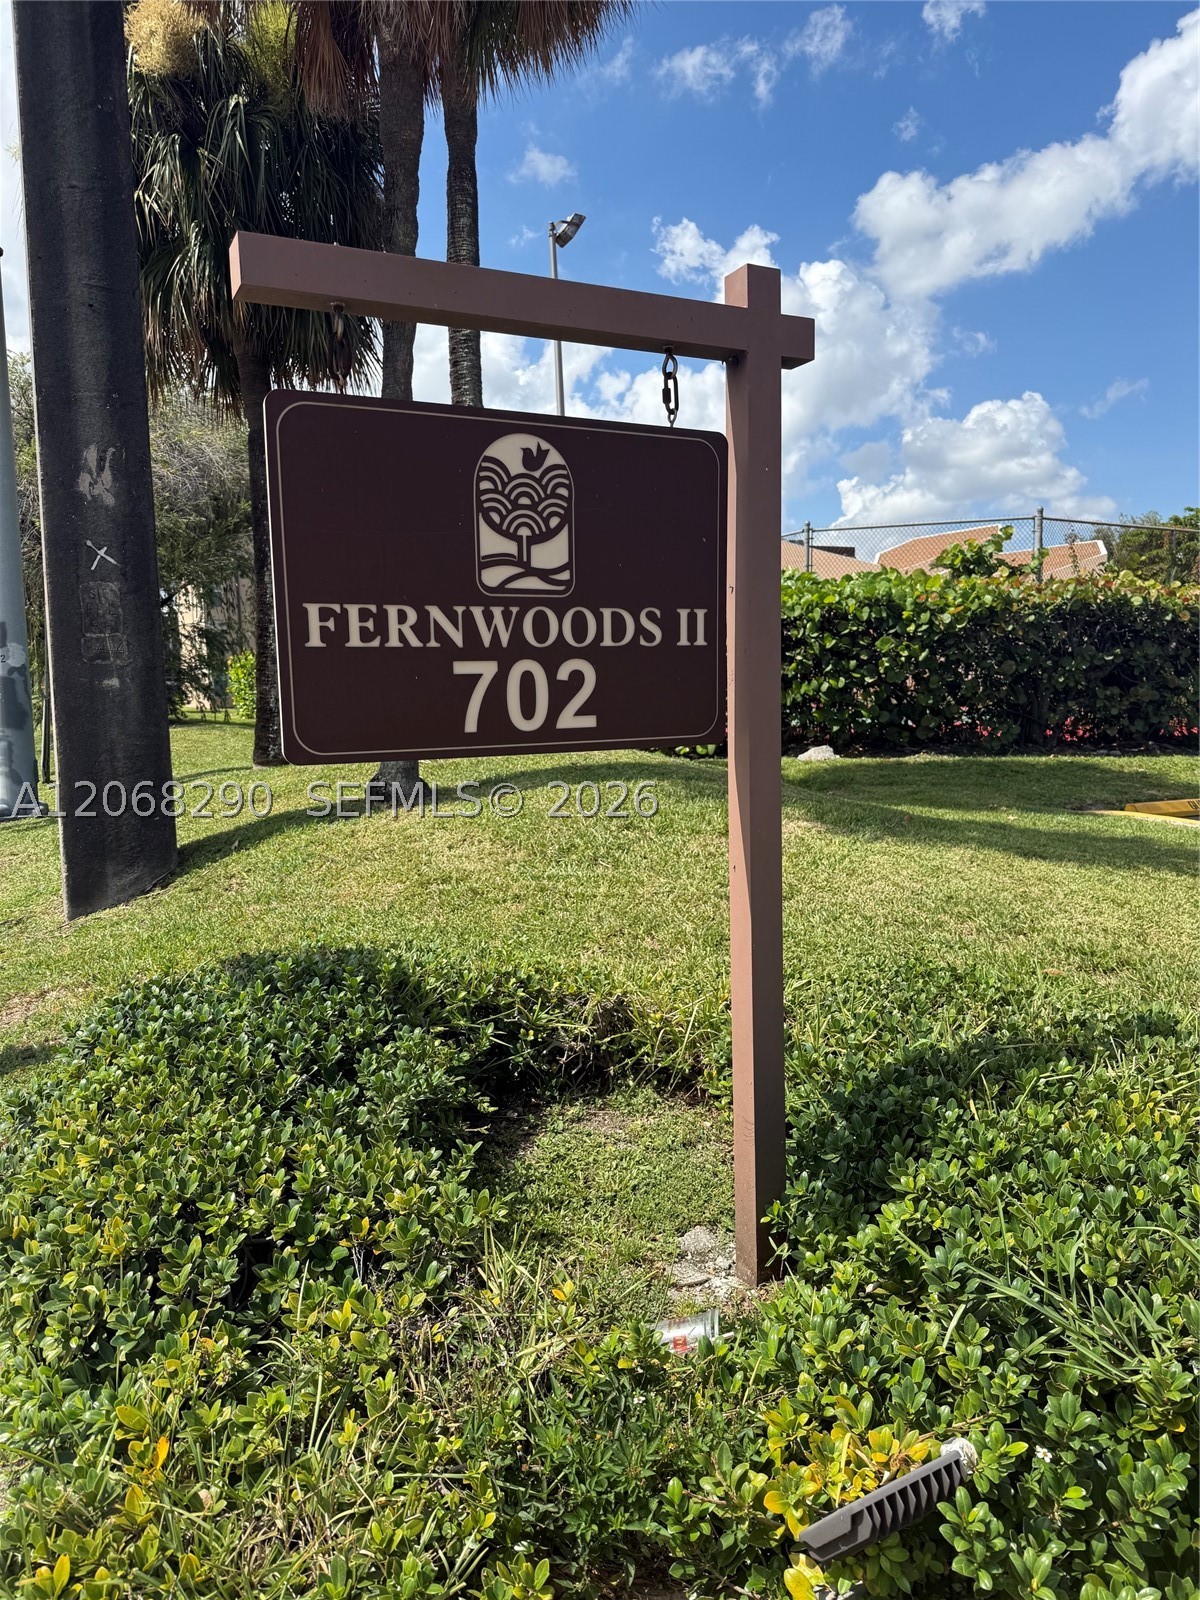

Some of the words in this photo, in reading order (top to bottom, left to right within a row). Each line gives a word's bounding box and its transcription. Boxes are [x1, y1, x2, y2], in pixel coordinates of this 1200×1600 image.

[302, 602, 663, 649] FERNWOODS
[676, 607, 709, 647] II
[452, 658, 598, 734] 702
